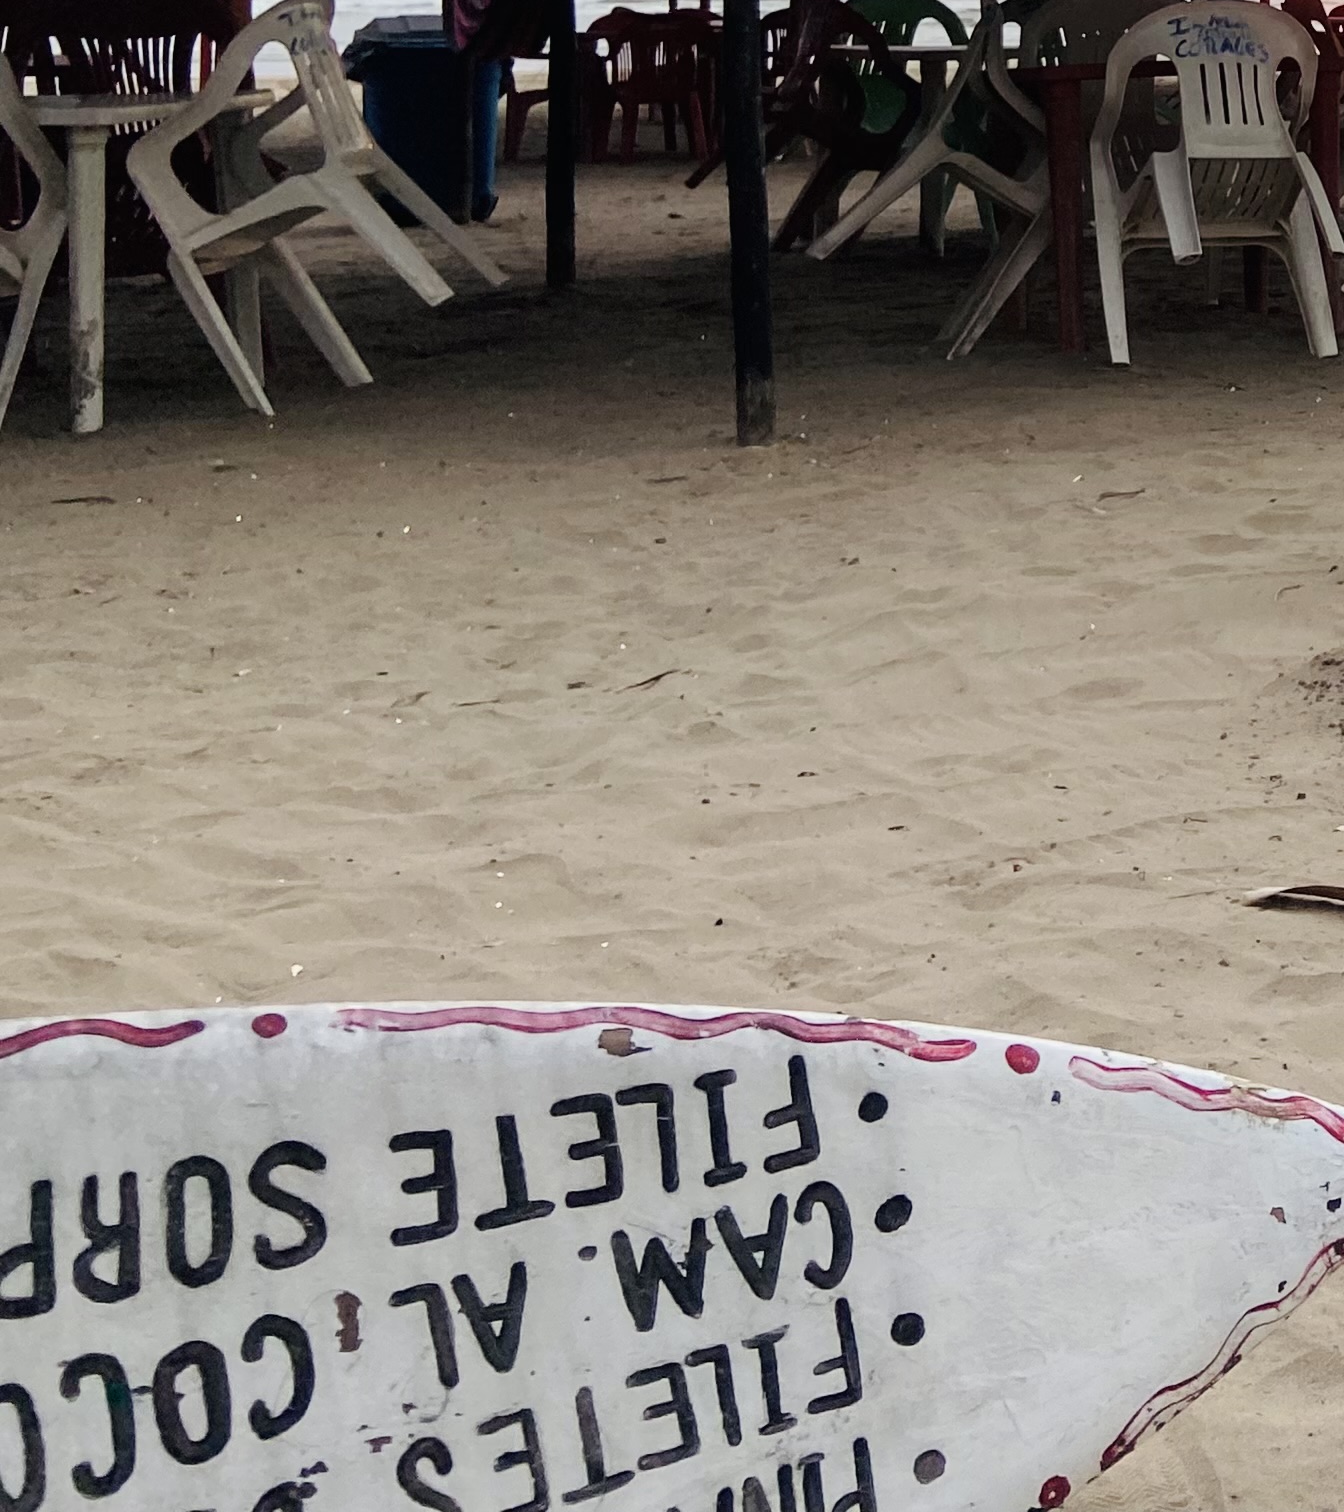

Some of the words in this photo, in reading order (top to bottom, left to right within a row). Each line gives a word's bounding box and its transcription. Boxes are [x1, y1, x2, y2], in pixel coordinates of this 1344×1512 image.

[0, 1140, 327, 1319] SORP
[389, 1055, 820, 1246] FILETE
[389, 1262, 527, 1390] AL
[578, 1181, 854, 1332] CAM.
[0, 1314, 315, 1512] COCO
[397, 1298, 863, 1512] FILETES
